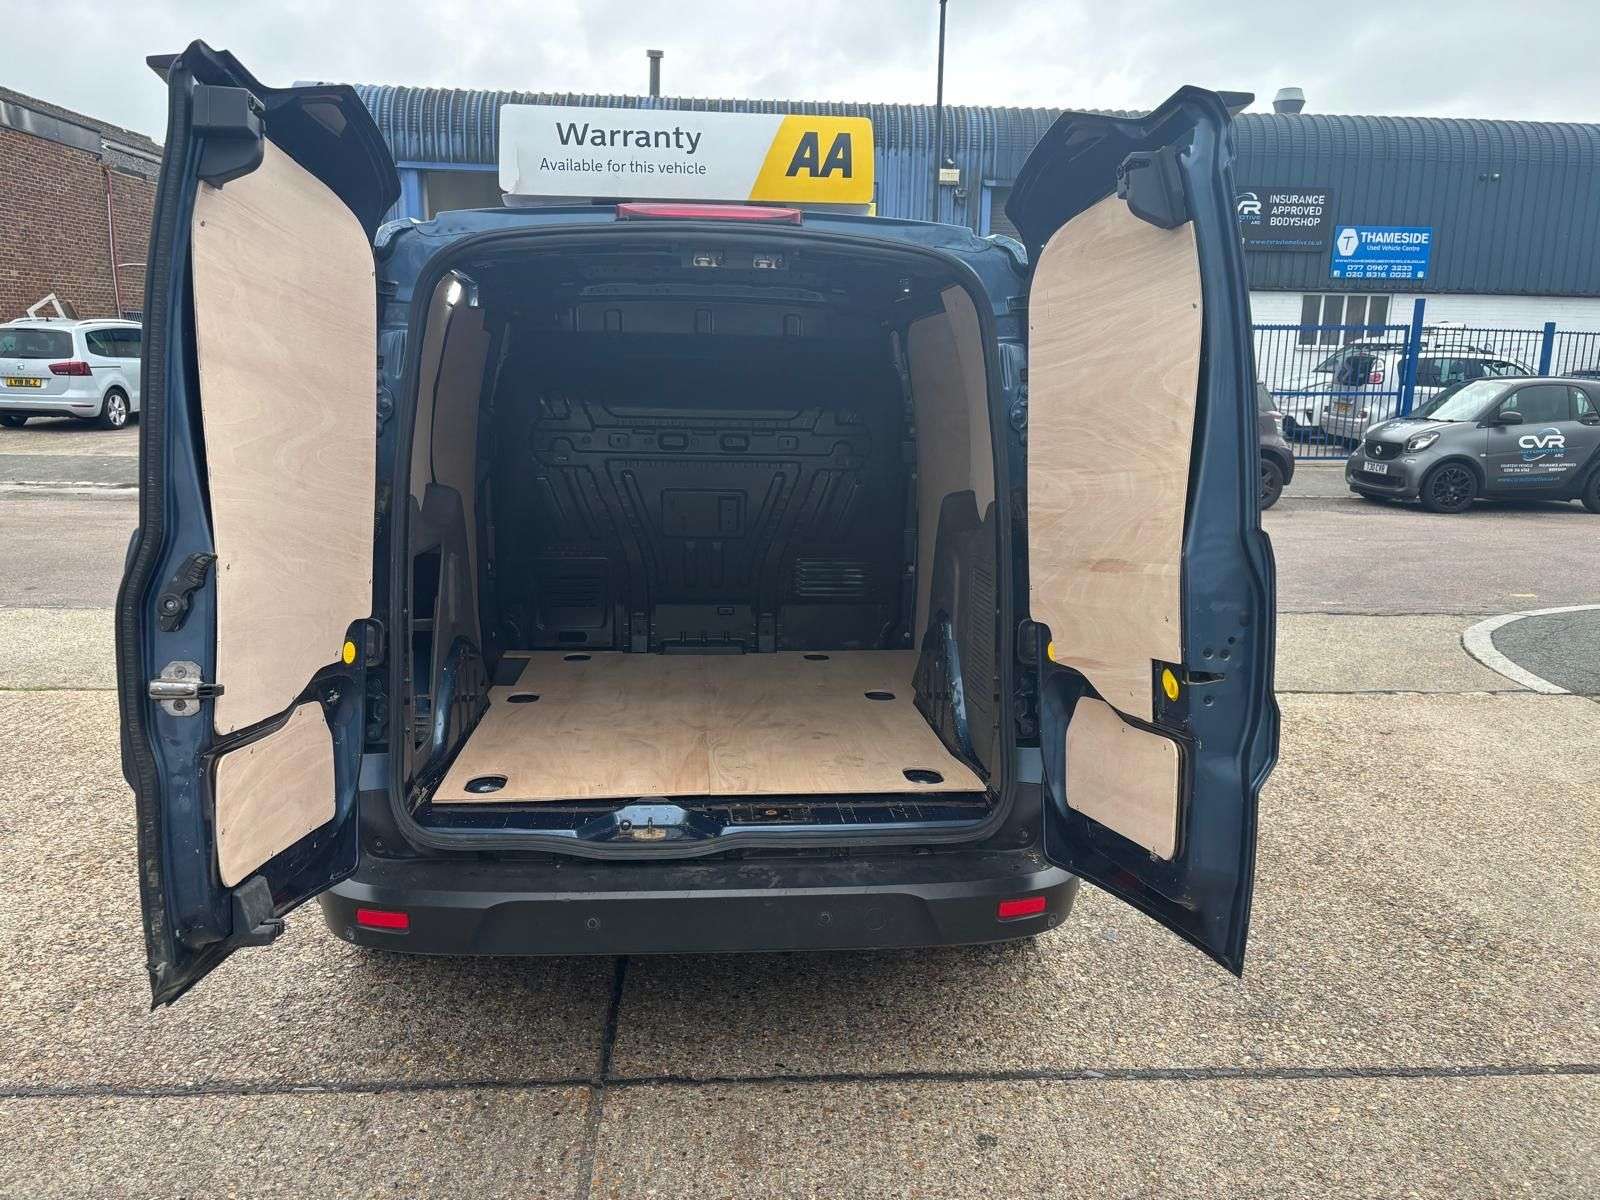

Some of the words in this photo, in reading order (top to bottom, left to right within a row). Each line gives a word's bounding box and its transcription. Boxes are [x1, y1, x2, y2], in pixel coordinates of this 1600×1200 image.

[556, 122, 702, 154] Warranty
[785, 131, 853, 179] AA
[540, 157, 603, 173] Available
[606, 159, 627, 173] for
[628, 159, 655, 174] this
[658, 161, 707, 176] vehicle
[1269, 194, 1326, 205] INSURANCE
[1271, 205, 1323, 216] APPROVED
[1269, 217, 1321, 227] BODYSHOP
[1343, 236, 1355, 251] T
[1359, 231, 1430, 244] THAMESIDE
[1518, 434, 1566, 449] CVR
